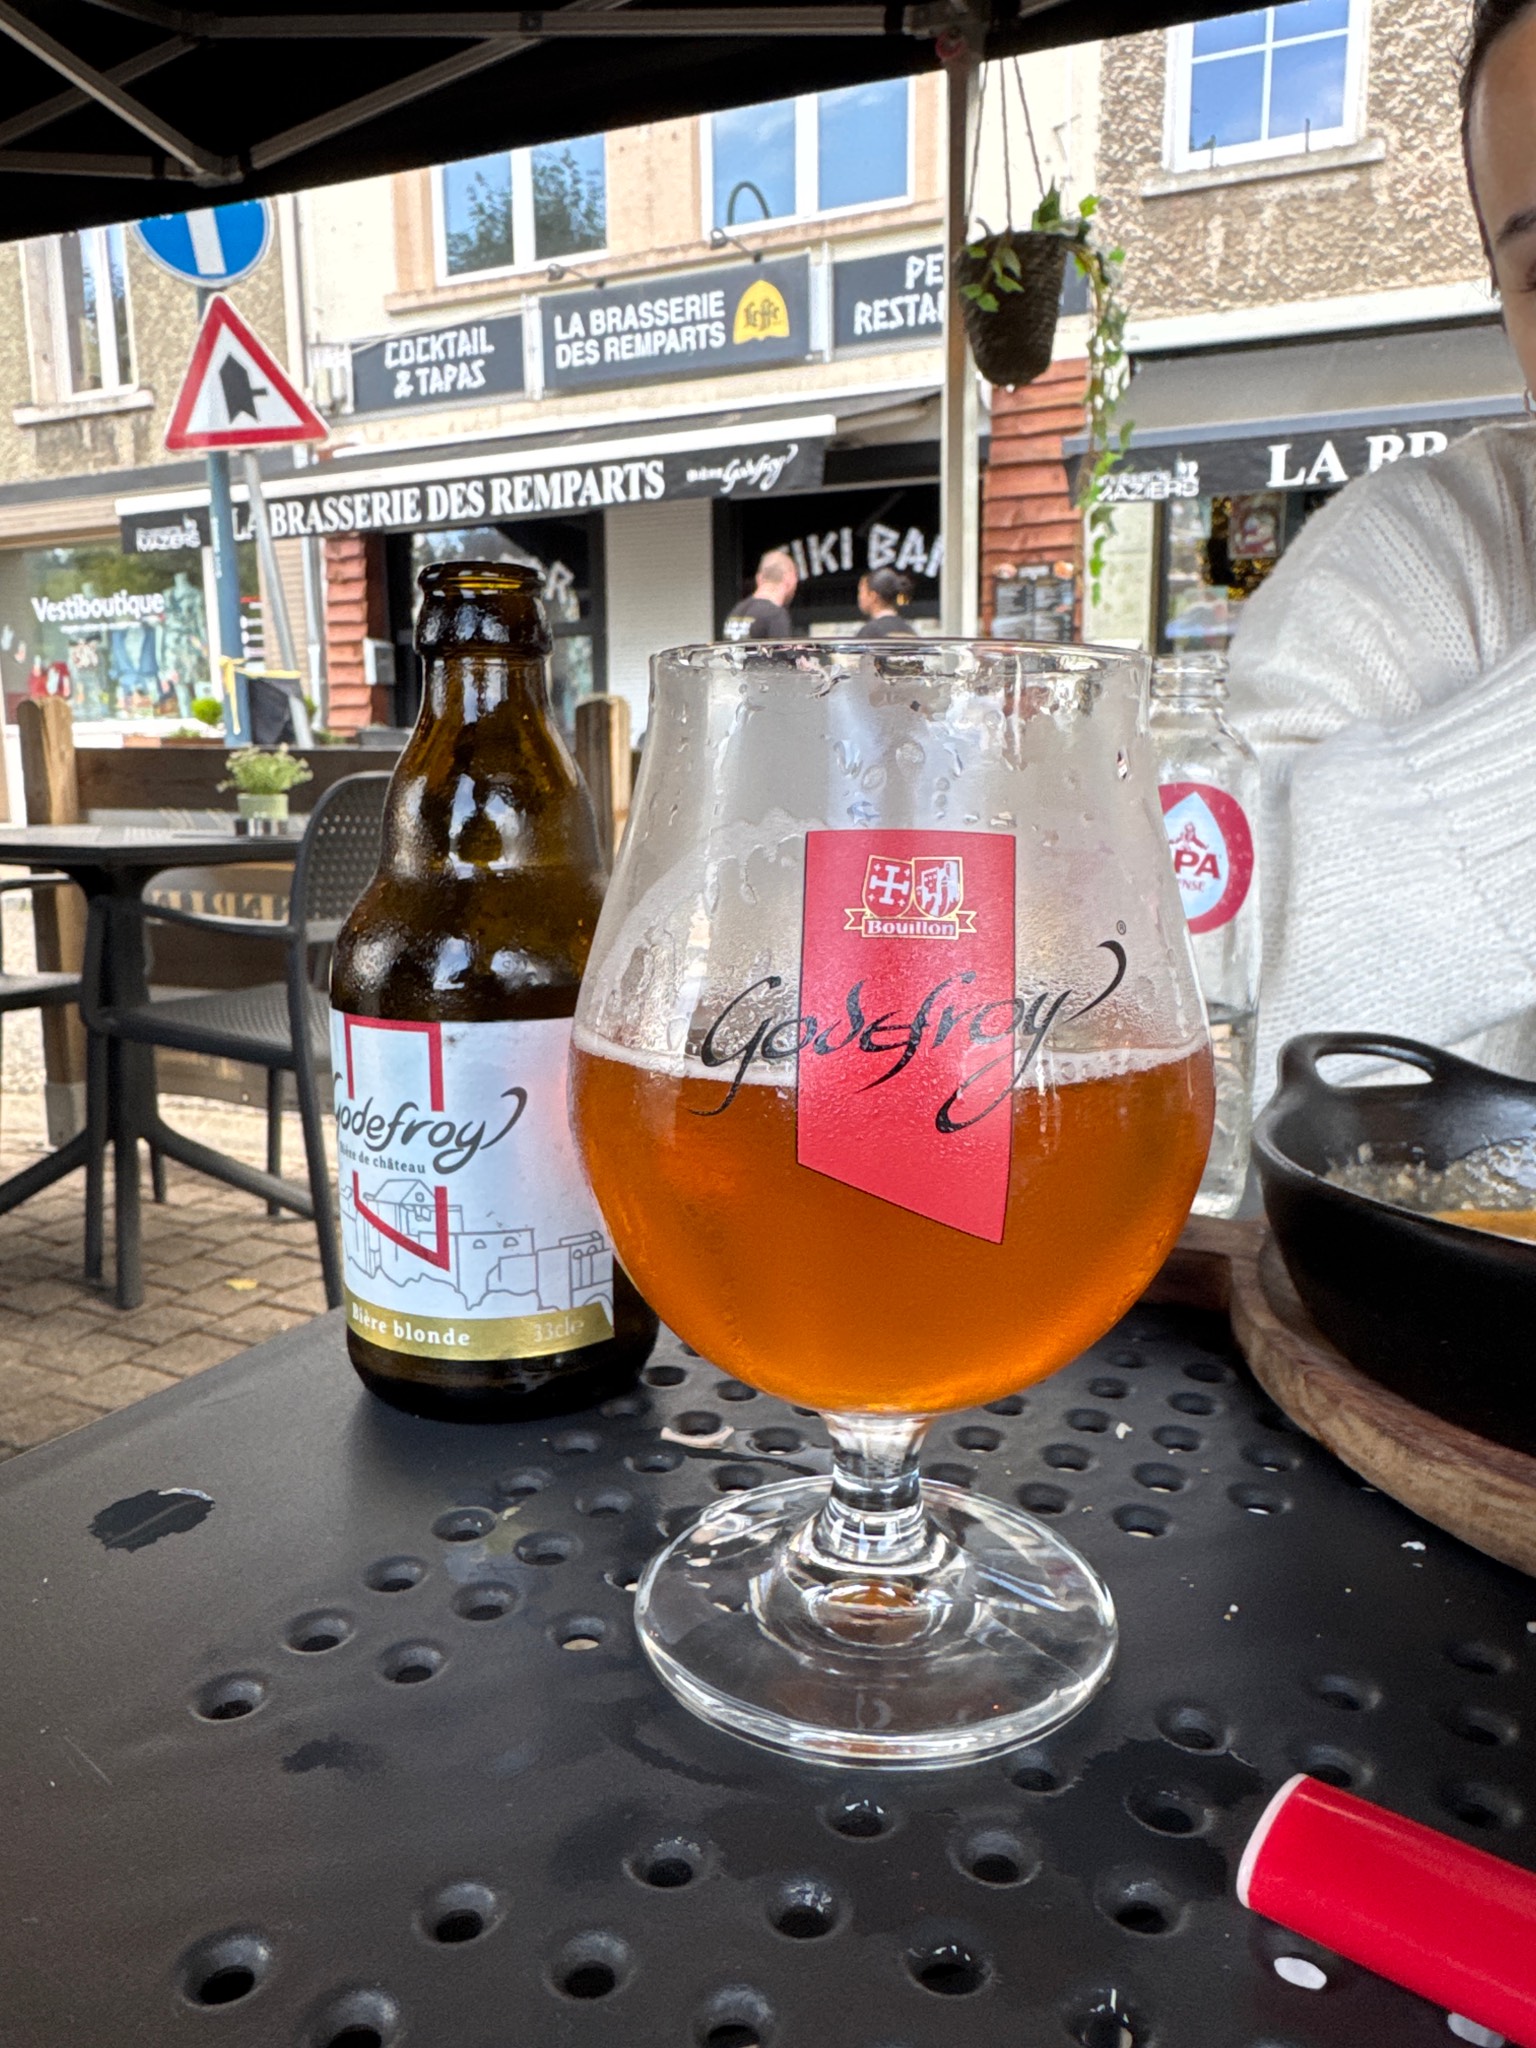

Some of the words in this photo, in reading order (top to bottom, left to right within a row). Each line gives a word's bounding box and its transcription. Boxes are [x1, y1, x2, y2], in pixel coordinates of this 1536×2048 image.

[554, 312, 585, 341] LA
[589, 290, 725, 337] BRASSERIE
[853, 290, 945, 336] RESTA
[384, 325, 496, 370] COCKTAIL
[555, 340, 601, 370] DES
[603, 321, 726, 363] REMPARTS
[393, 370, 414, 399] &
[415, 358, 486, 396] TAPAS
[1266, 440, 1349, 487] LA
[269, 487, 422, 537] BRASSERIE
[427, 479, 486, 521] DES
[490, 460, 665, 516] REMPARTS
[775, 526, 853, 582] IKI
[31, 589, 165, 622] Vestiboutique
[1174, 849, 1221, 880] PA
[867, 920, 955, 936] Bouillon
[687, 939, 1127, 1134] Godefroy
[373, 1155, 427, 1175] château
[352, 1302, 388, 1334] Bière
[393, 1320, 471, 1347] blonde
